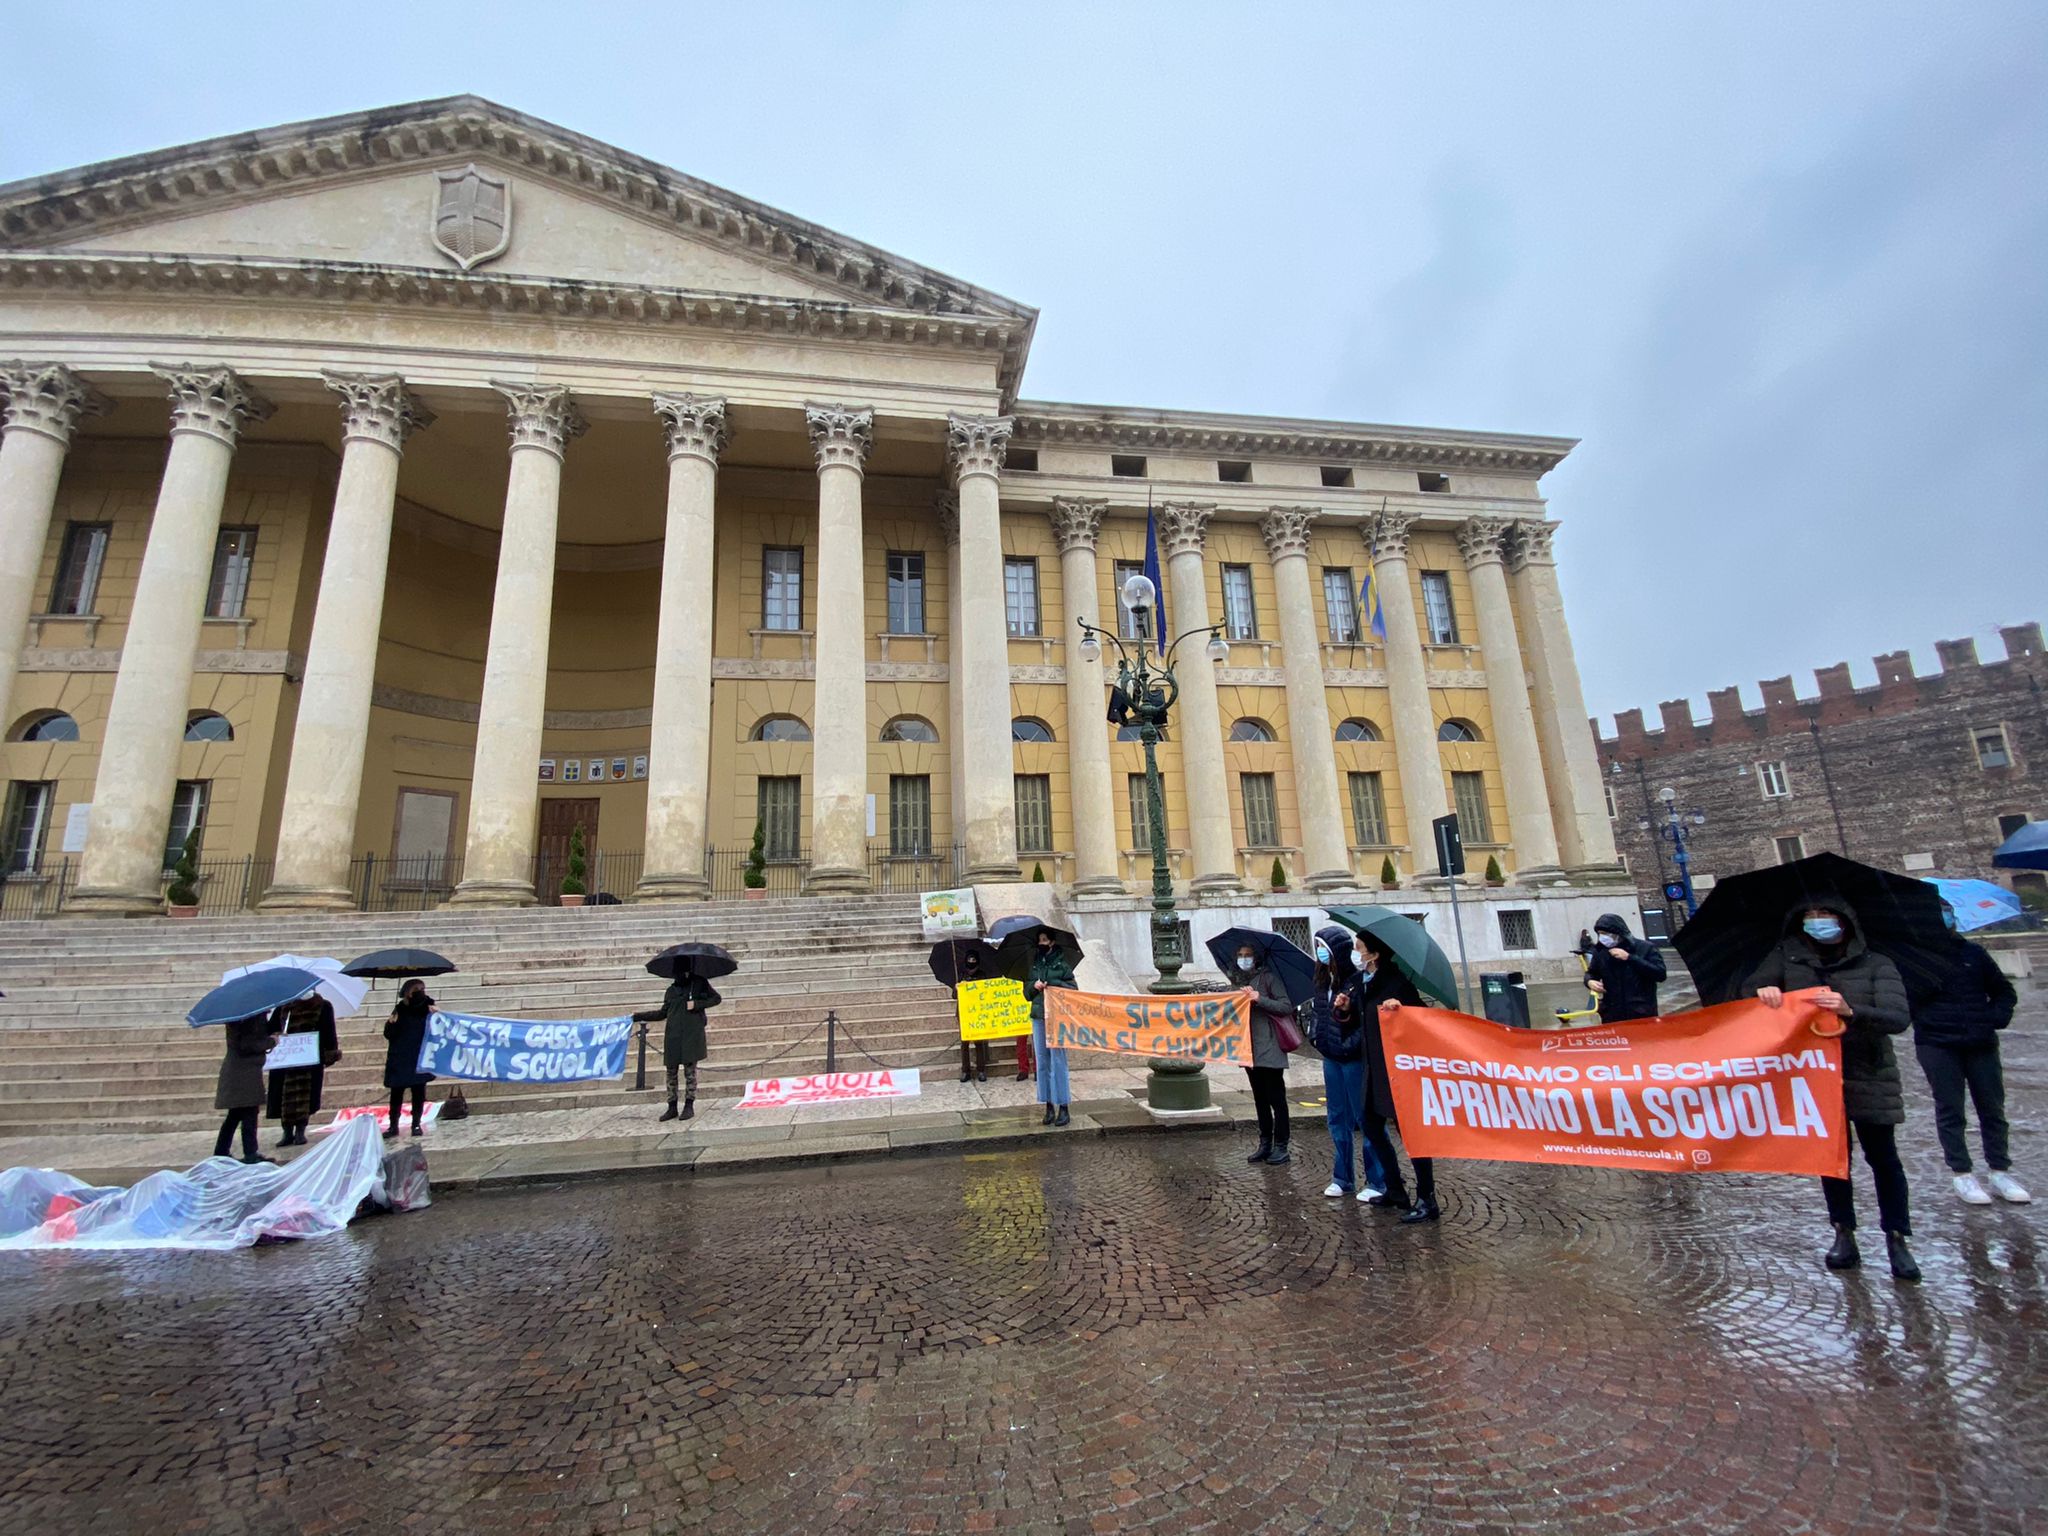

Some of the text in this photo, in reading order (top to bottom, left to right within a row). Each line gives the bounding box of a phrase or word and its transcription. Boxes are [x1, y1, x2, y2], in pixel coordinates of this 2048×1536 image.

[966, 983, 977, 991] LA
[993, 988, 1021, 999] SALUTE
[429, 1012, 629, 1049] QUESTA CASA NON
[1057, 1022, 1242, 1061] NON SI CHIUDE
[1567, 1036, 1629, 1047] La Scuola
[451, 1047, 498, 1078] UNA
[507, 1048, 610, 1081] SCUOLA
[1394, 1048, 1837, 1083] SPEGNIAMO GLI SCHERMI,
[752, 1078, 781, 1094] LA
[792, 1071, 894, 1090] SCUOLA
[1420, 1076, 1829, 1141] APRIAMO LA SCUOLA
[1543, 1142, 1685, 1162] www.ridatecilascuola.it
